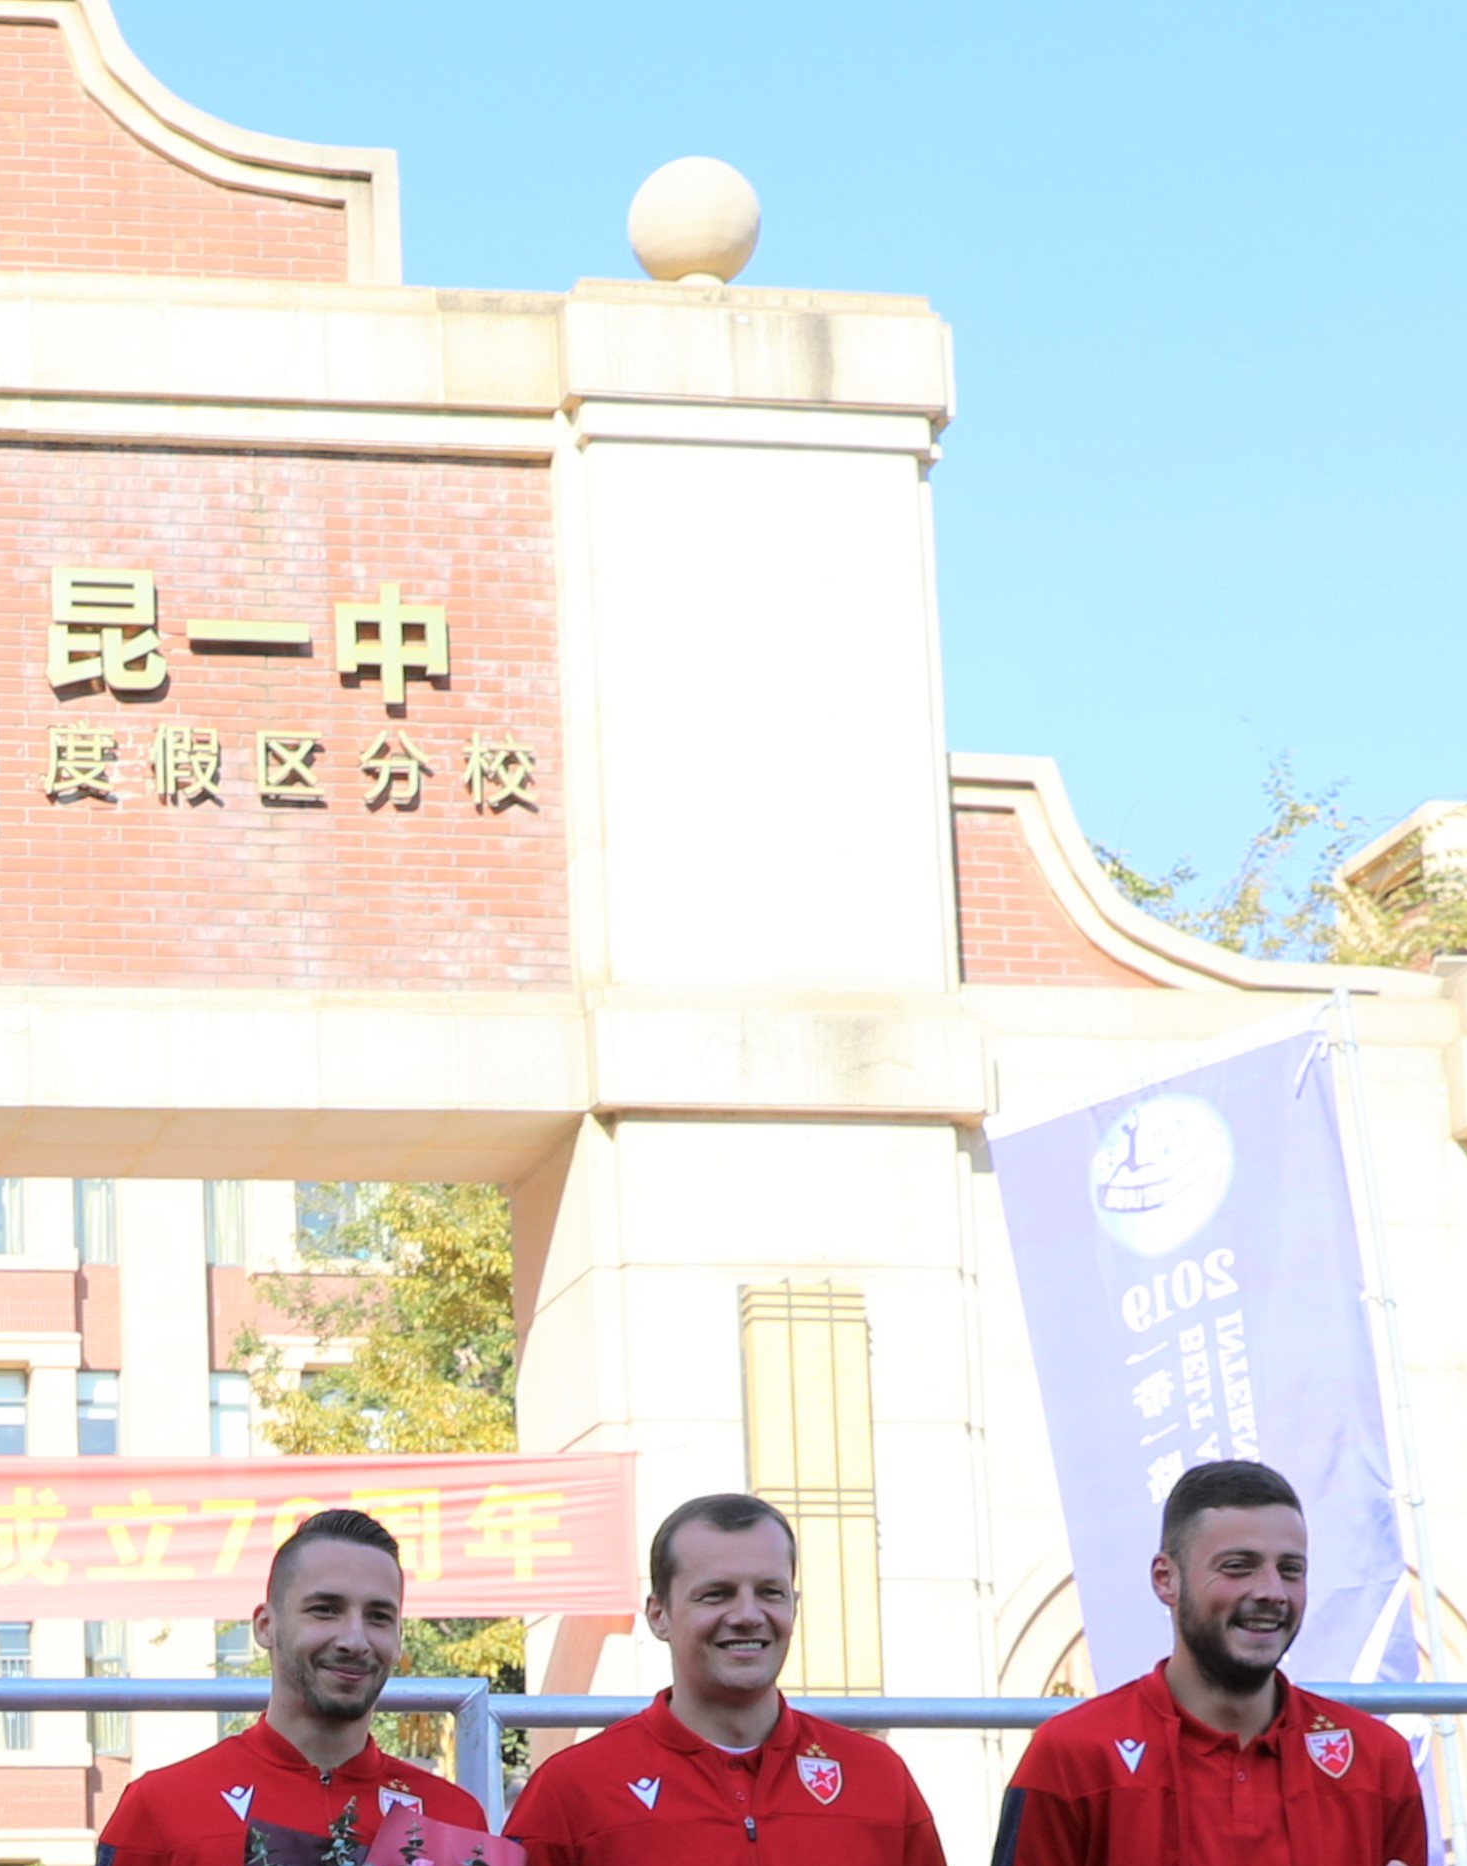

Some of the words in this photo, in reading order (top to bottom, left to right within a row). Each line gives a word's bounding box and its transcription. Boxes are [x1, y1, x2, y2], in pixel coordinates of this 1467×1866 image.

[45, 567, 449, 704] 昆一中
[44, 721, 539, 808] 度假区分校
